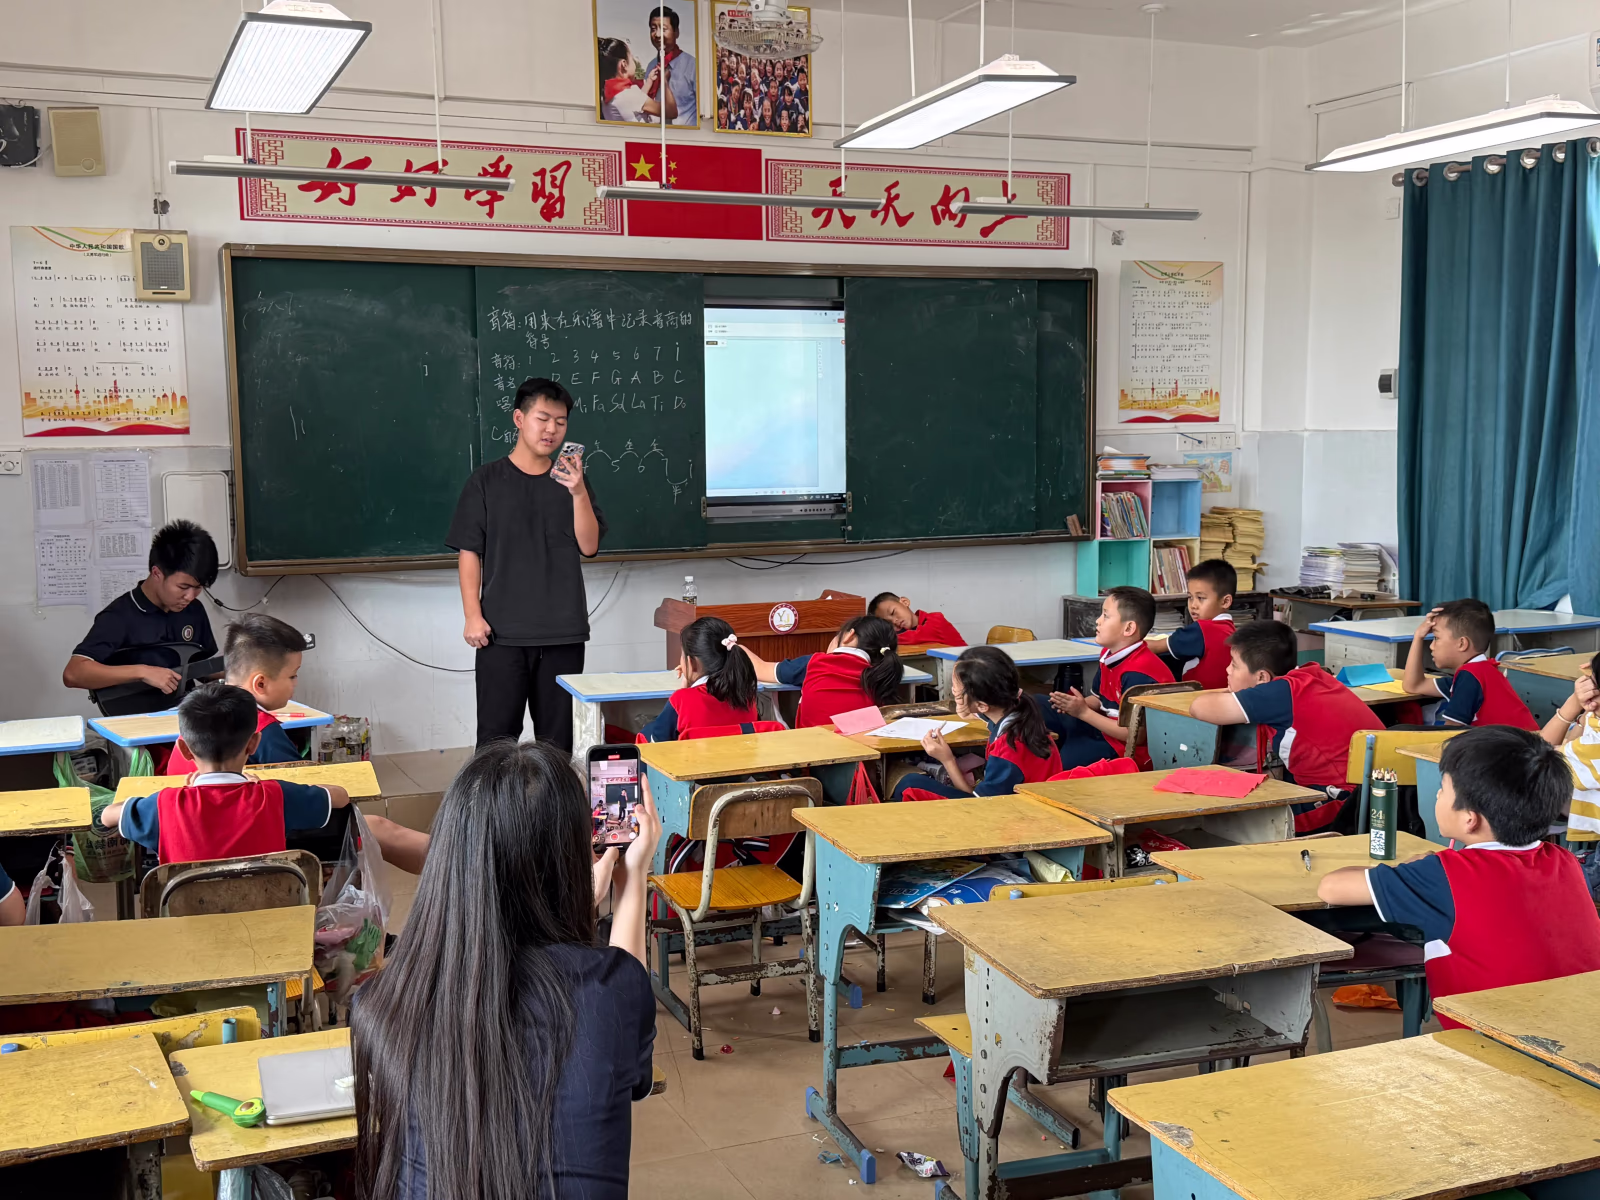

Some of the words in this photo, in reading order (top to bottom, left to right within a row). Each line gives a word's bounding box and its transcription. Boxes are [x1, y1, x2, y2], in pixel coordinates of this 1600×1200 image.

[526, 331, 550, 349] 符号
[550, 352, 560, 363] 2
[573, 349, 580, 364] 3
[590, 350, 599, 363] 4
[612, 350, 621, 360] 5
[633, 346, 640, 360] 6
[653, 346, 661, 361] 7
[571, 372, 583, 385] E
[591, 371, 600, 385] F
[611, 369, 622, 386] G
[630, 370, 642, 384] A
[652, 370, 664, 385] B
[674, 369, 686, 384] C
[496, 395, 515, 413] 唱
[592, 394, 606, 412] Fa
[631, 393, 646, 410] La
[650, 394, 664, 412] Ti
[673, 395, 687, 410] Do
[611, 459, 621, 473] 5
[637, 458, 645, 473] 6
[1371, 808, 1383, 819] 24
